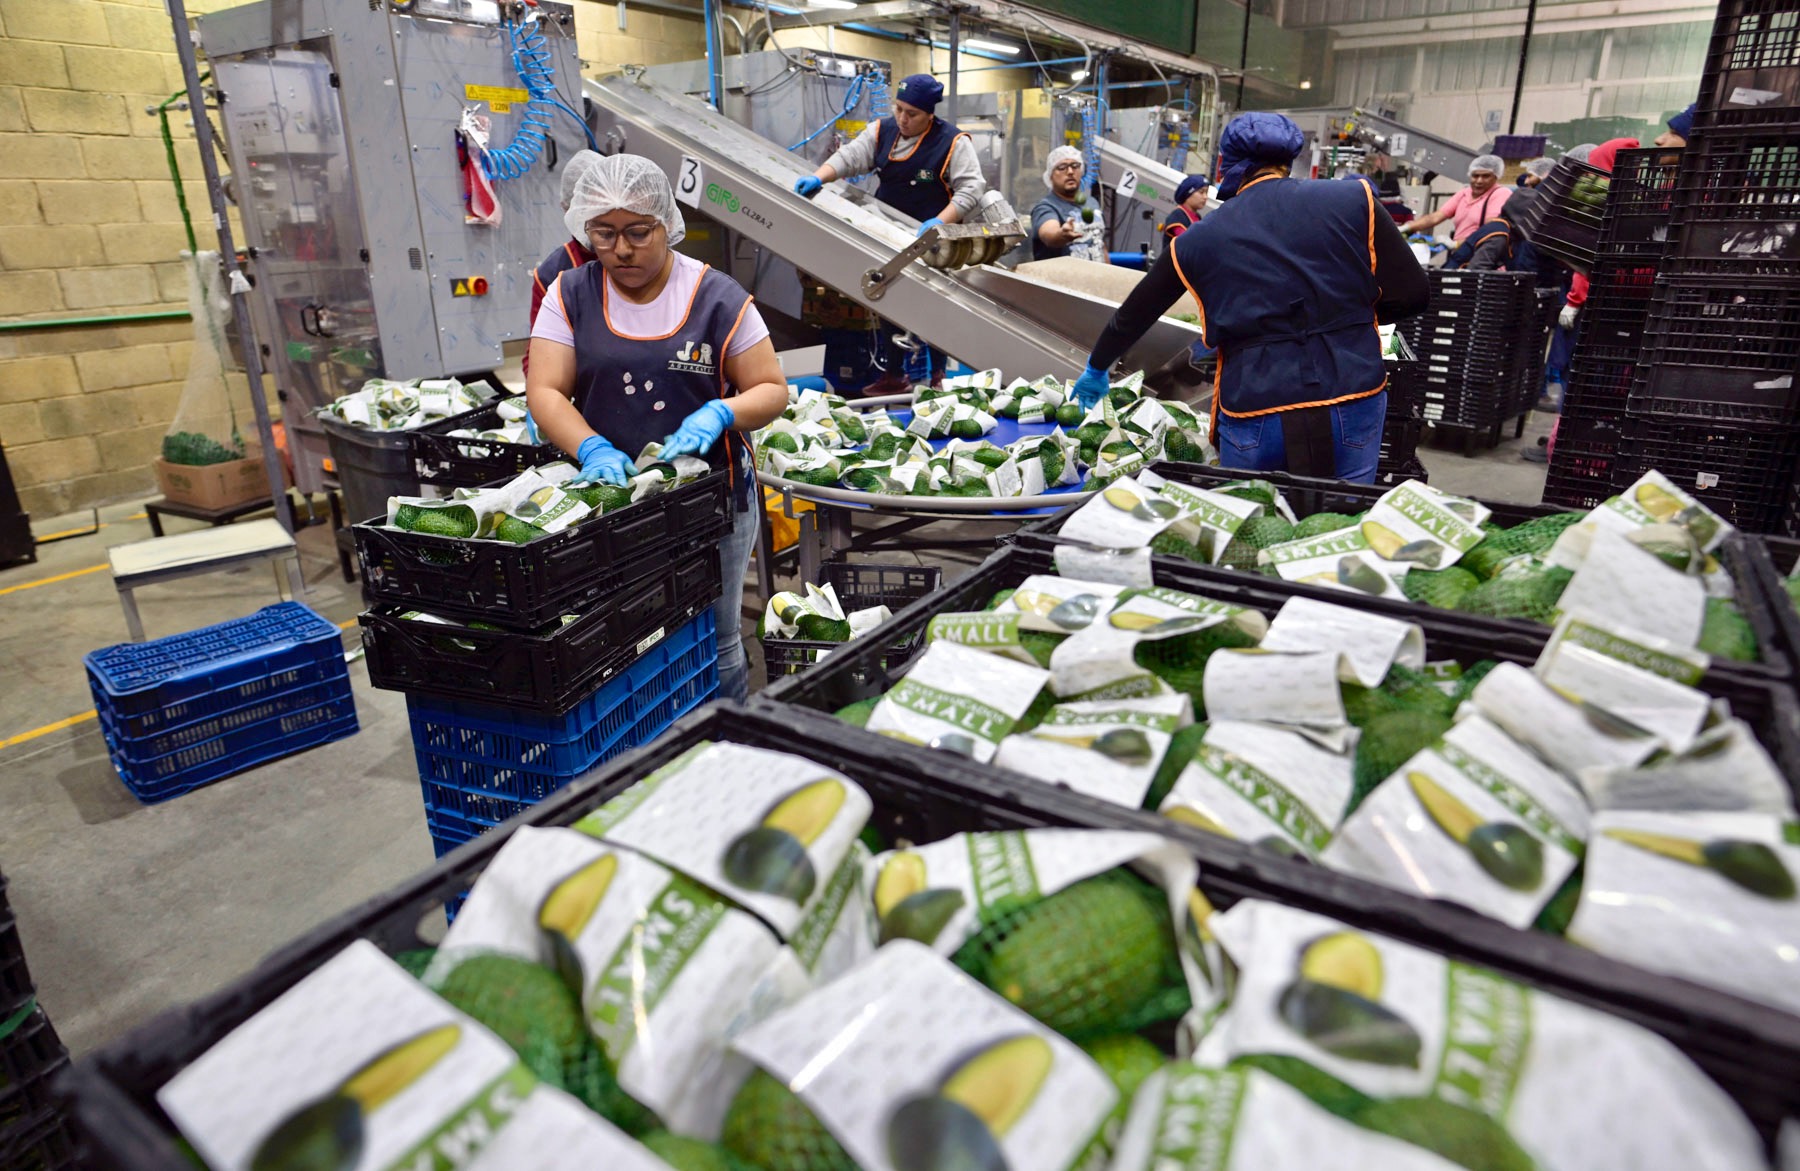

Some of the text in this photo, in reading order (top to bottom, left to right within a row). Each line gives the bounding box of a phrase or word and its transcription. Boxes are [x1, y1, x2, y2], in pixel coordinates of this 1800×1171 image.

[682, 158, 698, 193] 3
[1123, 171, 1136, 189] 2
[1111, 461, 1143, 478] SMALL
[536, 497, 573, 527] SMALL
[1391, 496, 1462, 547] SMALL
[1275, 537, 1362, 563] SMALL
[932, 624, 1010, 644] SMALL
[896, 688, 993, 737] SMALL
[1206, 752, 1315, 846] SMALL
